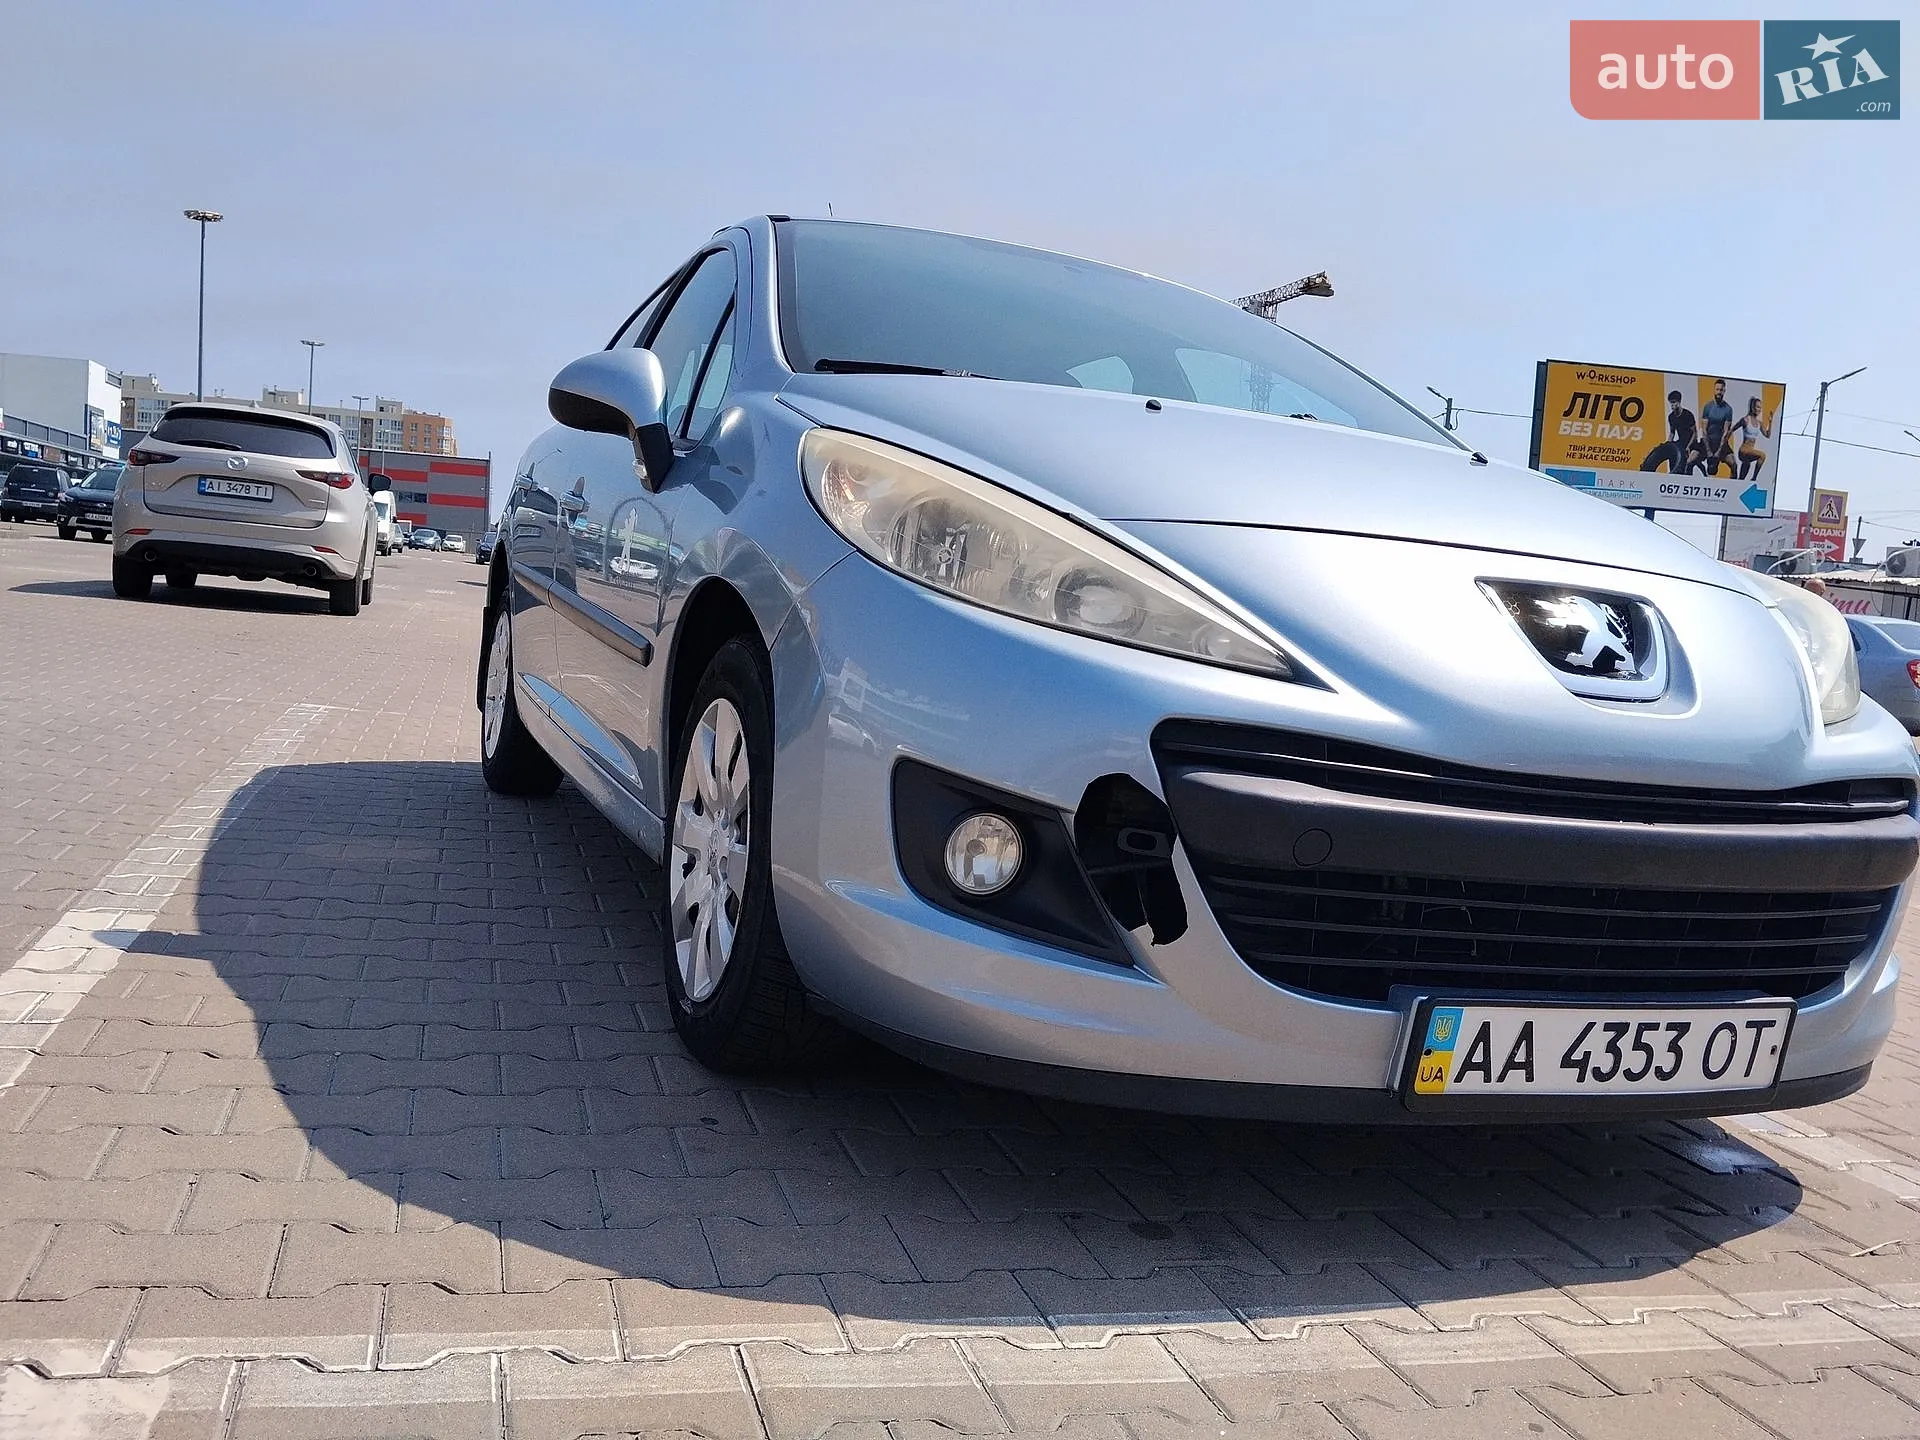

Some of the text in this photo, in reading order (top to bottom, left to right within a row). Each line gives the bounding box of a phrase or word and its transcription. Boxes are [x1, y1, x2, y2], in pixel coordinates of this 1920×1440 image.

[1562, 391, 1644, 423] ЛІТО
[1559, 420, 1644, 441] БЕЗ ПАУЗ
[1569, 444, 1630, 455] ТВІЙ РЕЗУЛЬТАТ
[1600, 454, 1631, 463] СЕЗОНУ
[207, 483, 268, 496] AI 3478 TI
[1597, 478, 1637, 489] ПАРК
[1659, 484, 1727, 498] 067 517 11 47
[1453, 1020, 1777, 1084] AA 4353 OT
[1420, 1066, 1443, 1083] UA
